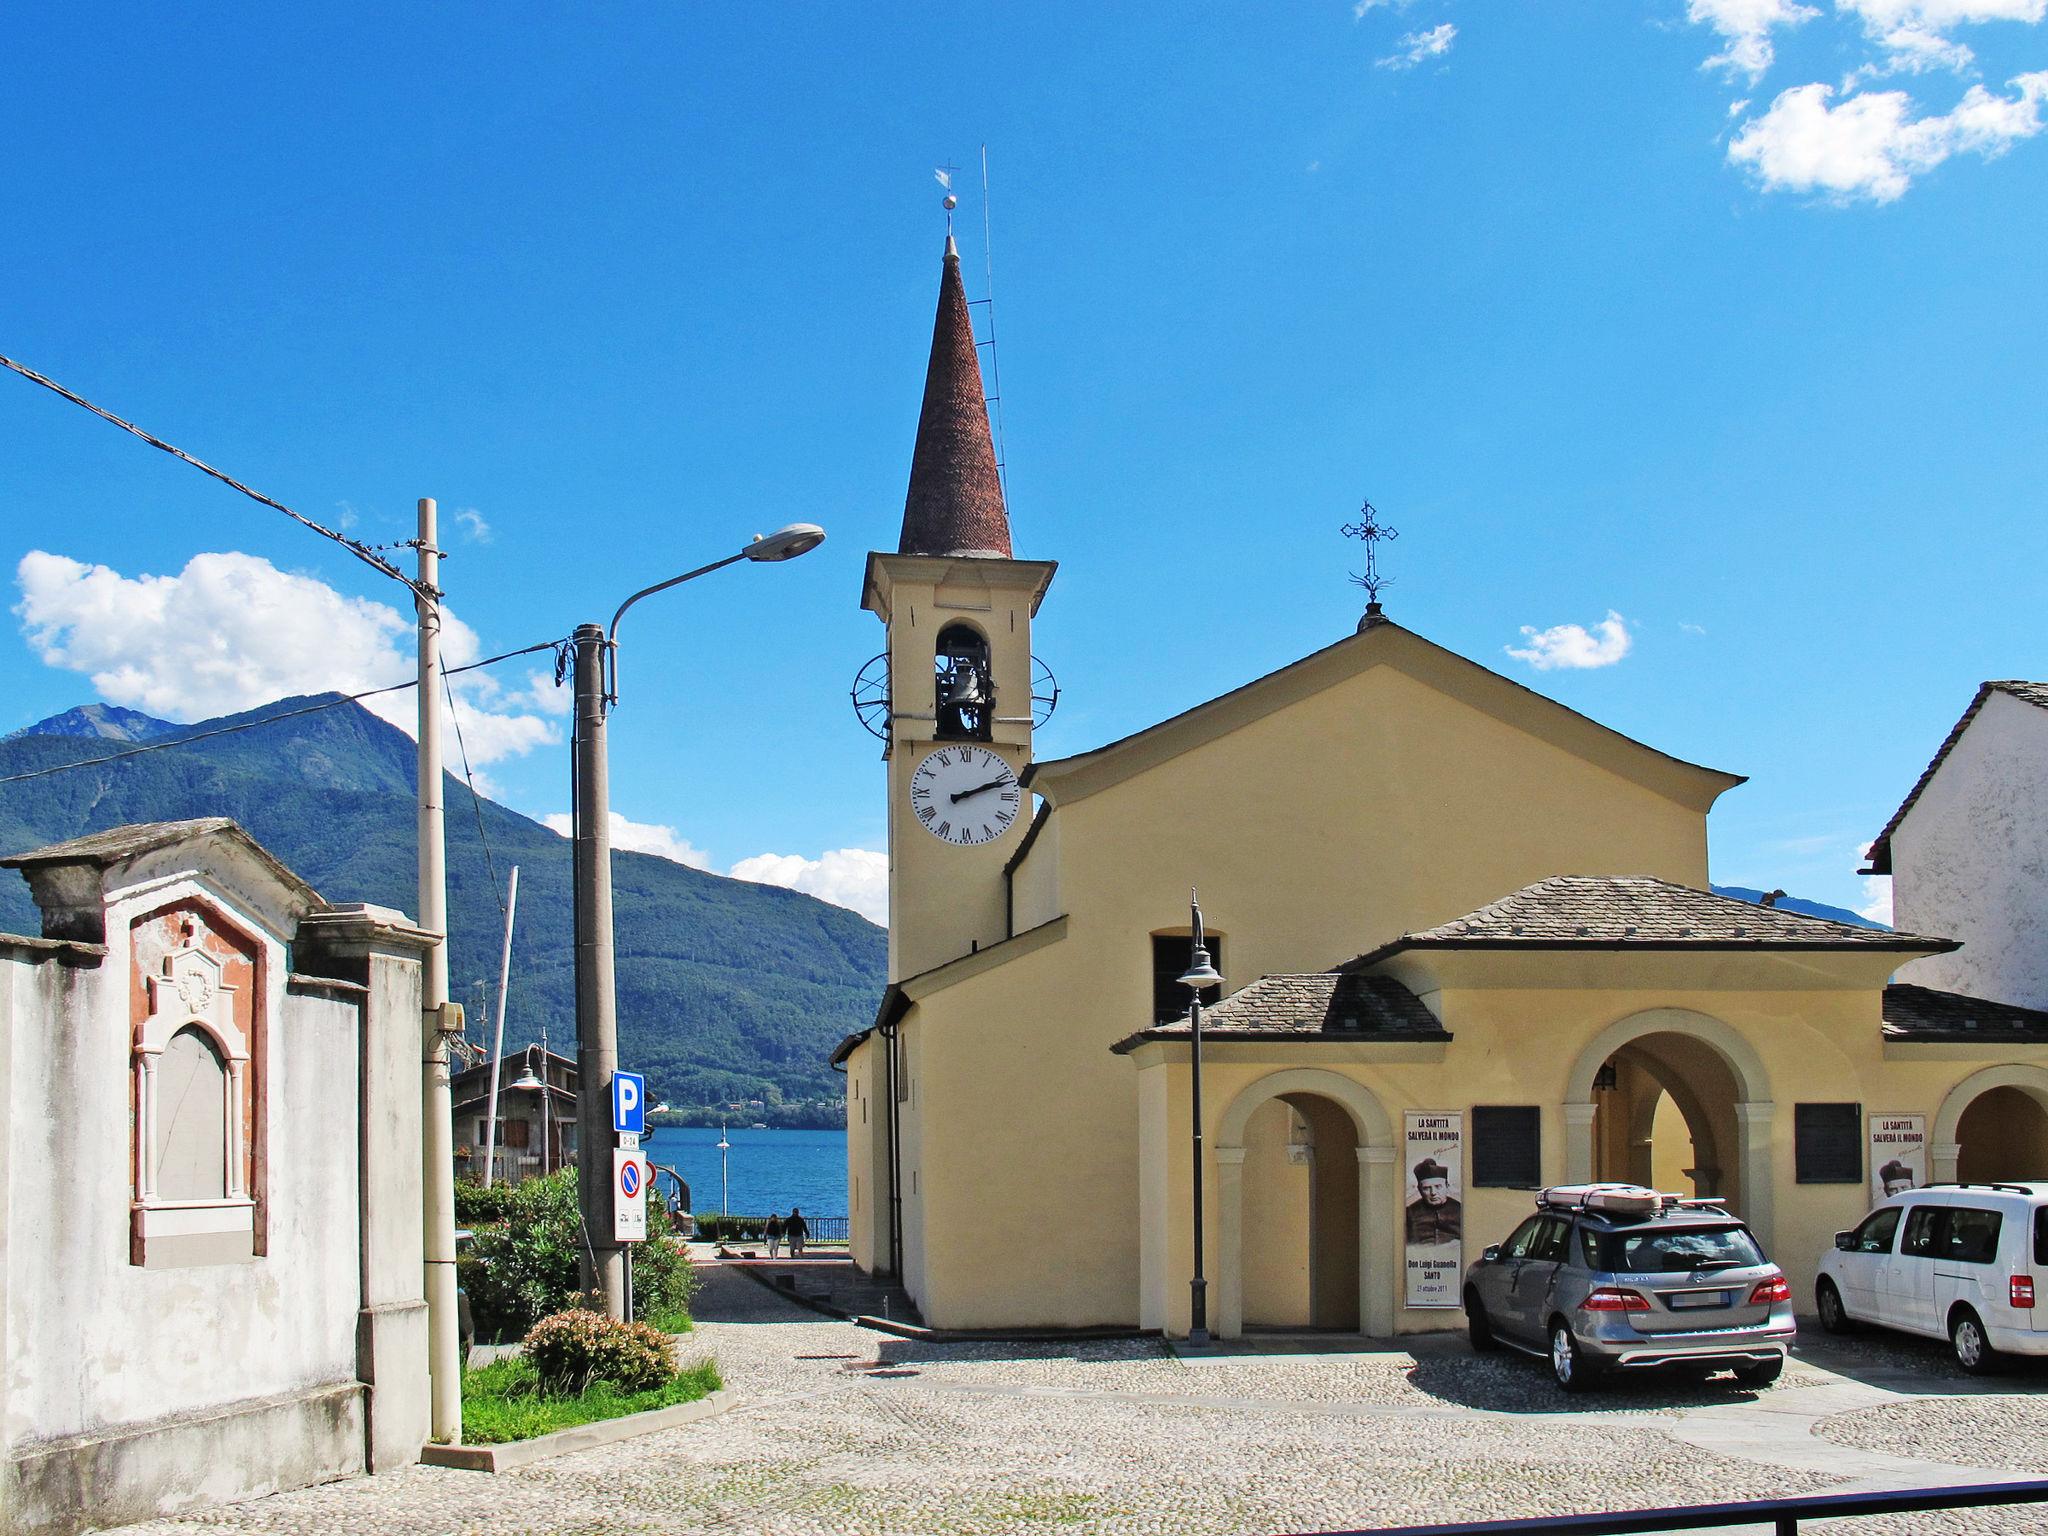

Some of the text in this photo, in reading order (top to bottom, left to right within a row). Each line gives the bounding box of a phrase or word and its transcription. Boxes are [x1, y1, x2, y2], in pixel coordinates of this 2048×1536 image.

[937, 754, 951, 768] XI
[960, 750, 972, 762] XII
[922, 768, 936, 779] X
[917, 788, 930, 798] IX
[1001, 793, 1014, 801] III
[921, 806, 937, 822] VIII
[995, 810, 1009, 824] IV
[938, 821, 951, 836] VII
[962, 828, 971, 840] VI
[983, 824, 992, 836] V
[618, 1078, 639, 1126] P
[1418, 1117, 1449, 1128] LA SANTITÀ
[1882, 1119, 1912, 1130] LA SANTITÀ
[1408, 1130, 1459, 1140] SALVERÀ IL MONDO
[1873, 1132, 1923, 1143] SALVERÀ IL MONDO
[1408, 1260, 1418, 1268] Don
[1419, 1259, 1432, 1269] Luigi
[1424, 1271, 1440, 1280] SANTO
